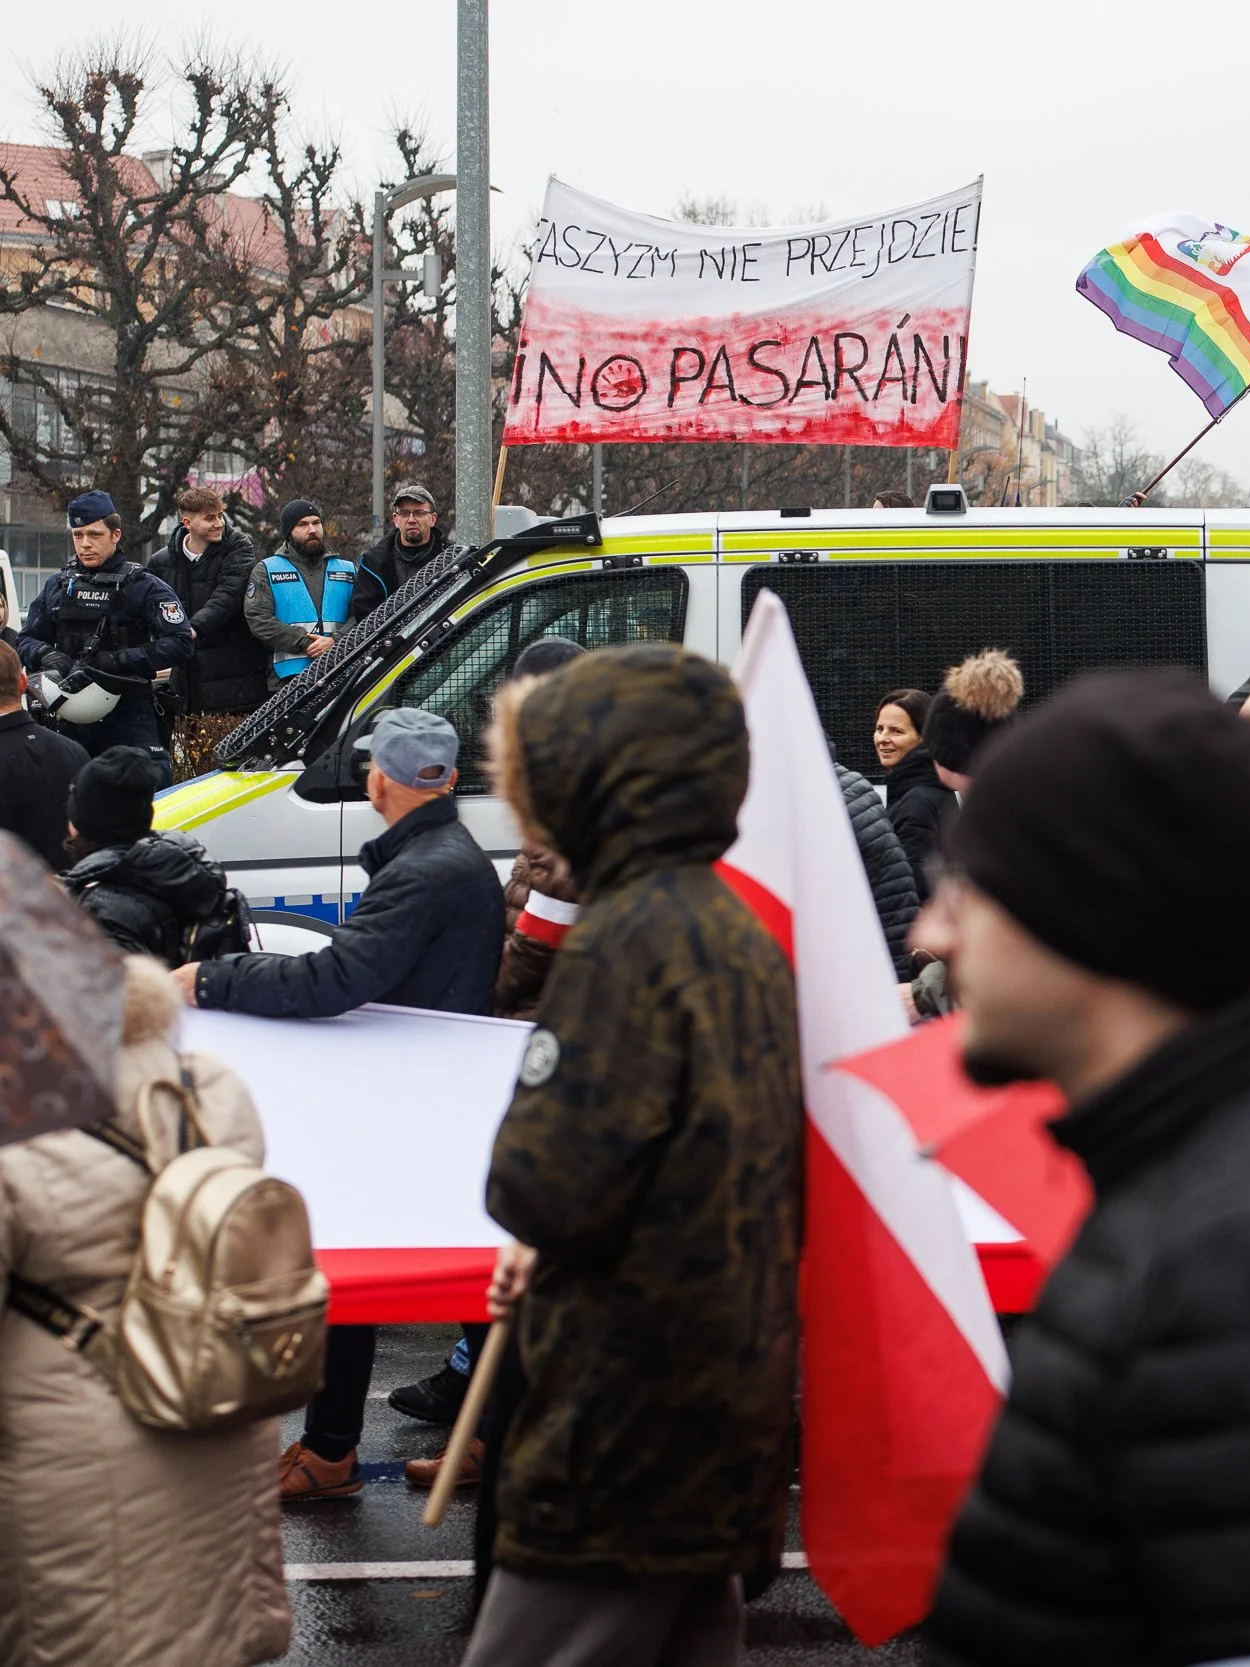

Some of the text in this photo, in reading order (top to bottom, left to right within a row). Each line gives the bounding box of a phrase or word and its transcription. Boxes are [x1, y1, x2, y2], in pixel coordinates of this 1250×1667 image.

[698, 243, 762, 281] NIE
[786, 201, 981, 279] PRZEJDZIE!
[271, 573, 298, 582] POLICJA
